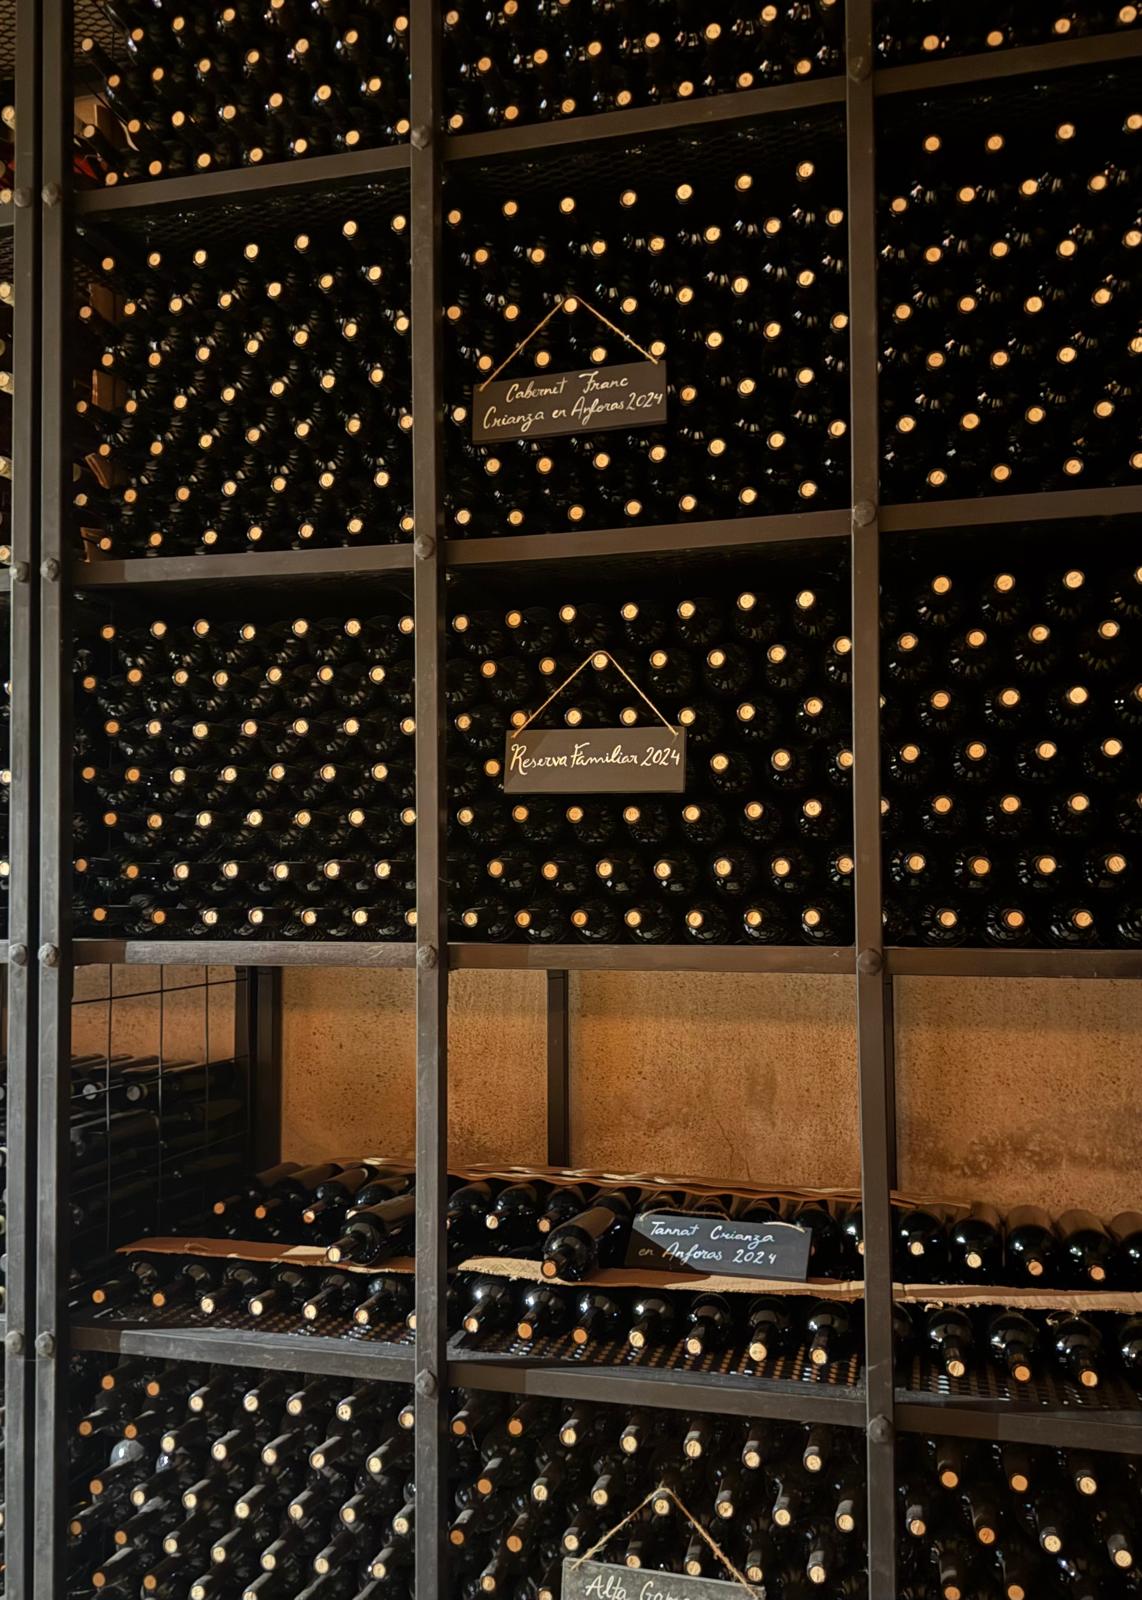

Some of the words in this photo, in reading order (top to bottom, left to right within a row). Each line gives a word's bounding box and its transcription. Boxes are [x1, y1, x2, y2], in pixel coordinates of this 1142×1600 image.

[506, 376, 568, 403] Cabernet
[578, 370, 629, 393] Franc
[483, 406, 545, 432] Crianza
[551, 407, 567, 419] en
[624, 392, 664, 411] 2024
[510, 743, 567, 775] Reserva
[570, 742, 639, 768] Familiar
[640, 746, 681, 767] 2024
[649, 1221, 700, 1236] Tannat
[710, 1225, 775, 1250] Crianza
[638, 1247, 653, 1257] en
[662, 1241, 723, 1265] Anforas
[732, 1249, 777, 1265] 2024
[585, 1574, 628, 1600] Alta
